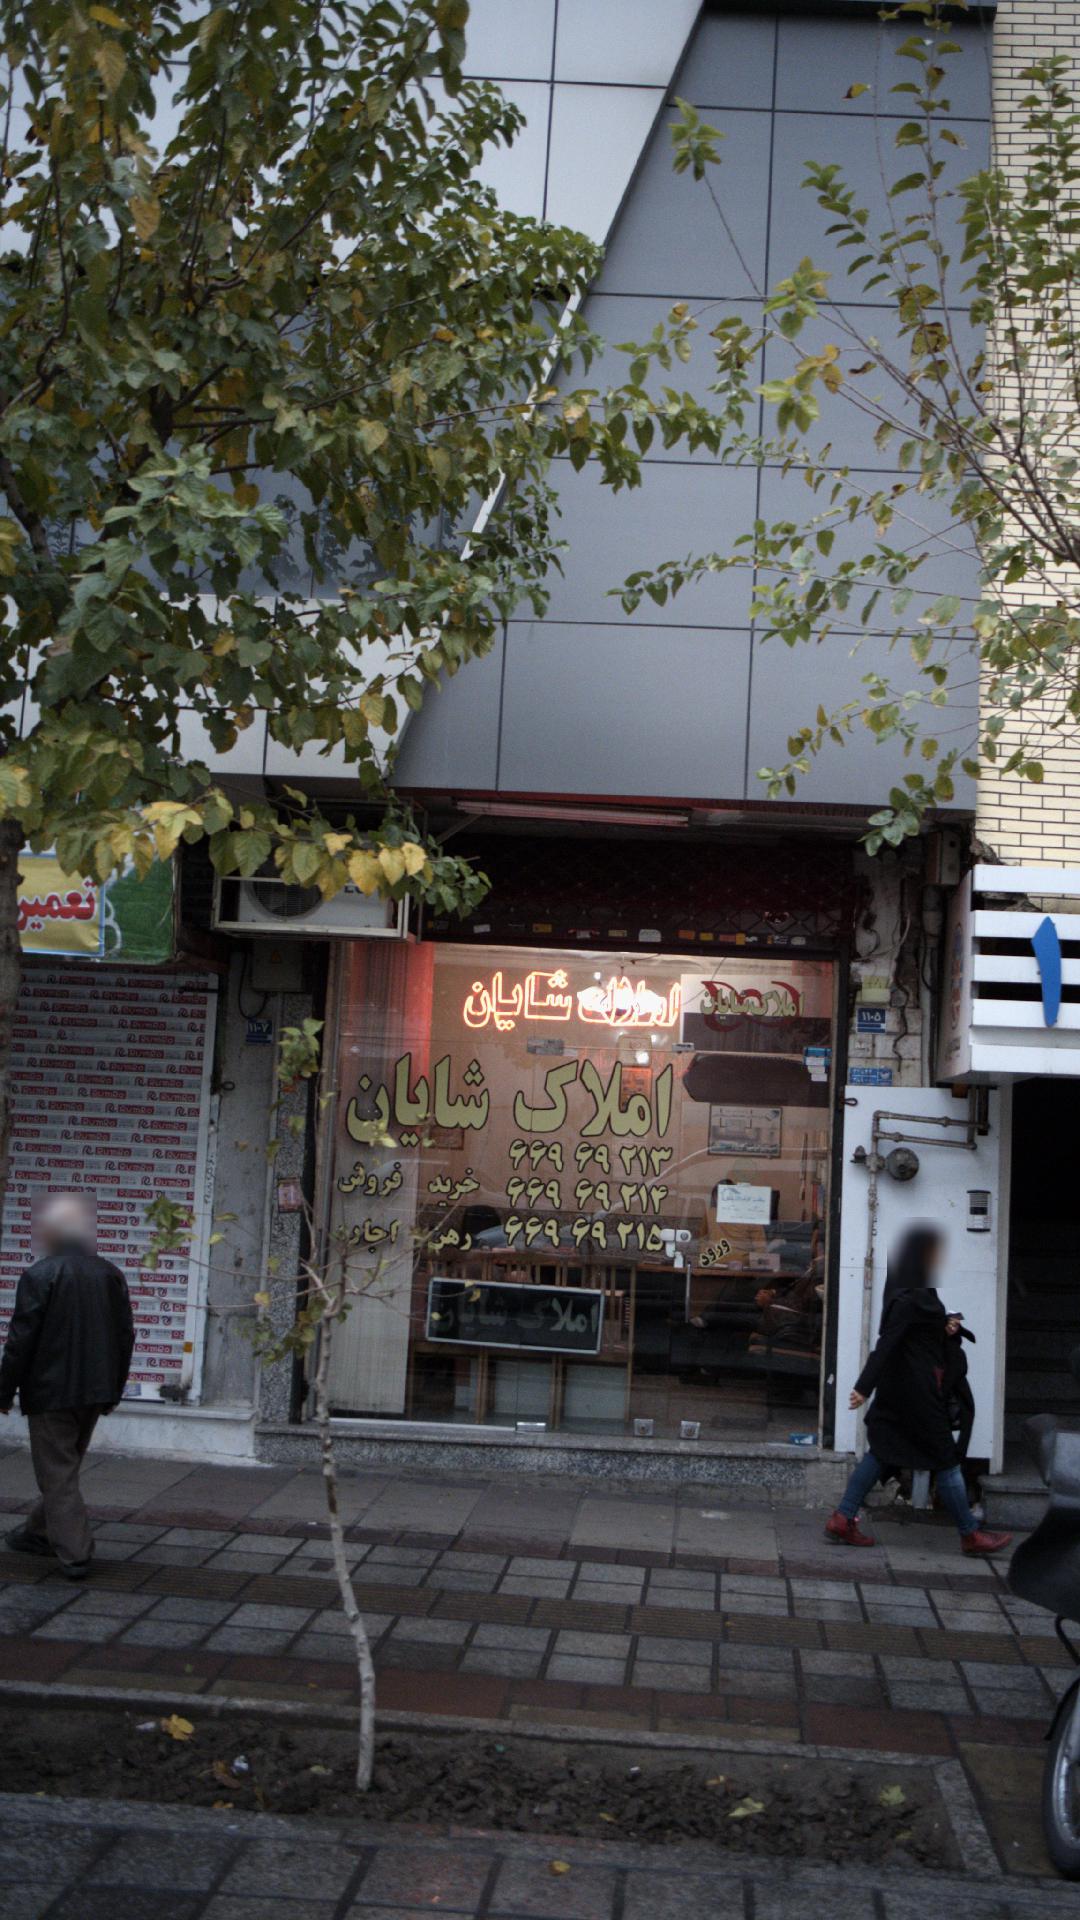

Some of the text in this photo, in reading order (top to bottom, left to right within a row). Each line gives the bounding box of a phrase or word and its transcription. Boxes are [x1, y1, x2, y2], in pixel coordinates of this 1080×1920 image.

[463, 969, 572, 1031] شایان
[345, 1052, 673, 1147] املاک شایان
[509, 1138, 673, 1177] ۶۶۹ ۶۹ ۲۱۳
[337, 1161, 481, 1207] خرید فروش
[506, 1176, 669, 1214] ۶۶۹ ۶۹ ۲۱۴
[504, 1215, 664, 1251] ۶۶۹ ۶۹ ۲۱۵
[701, 1239, 730, 1266] ورود
